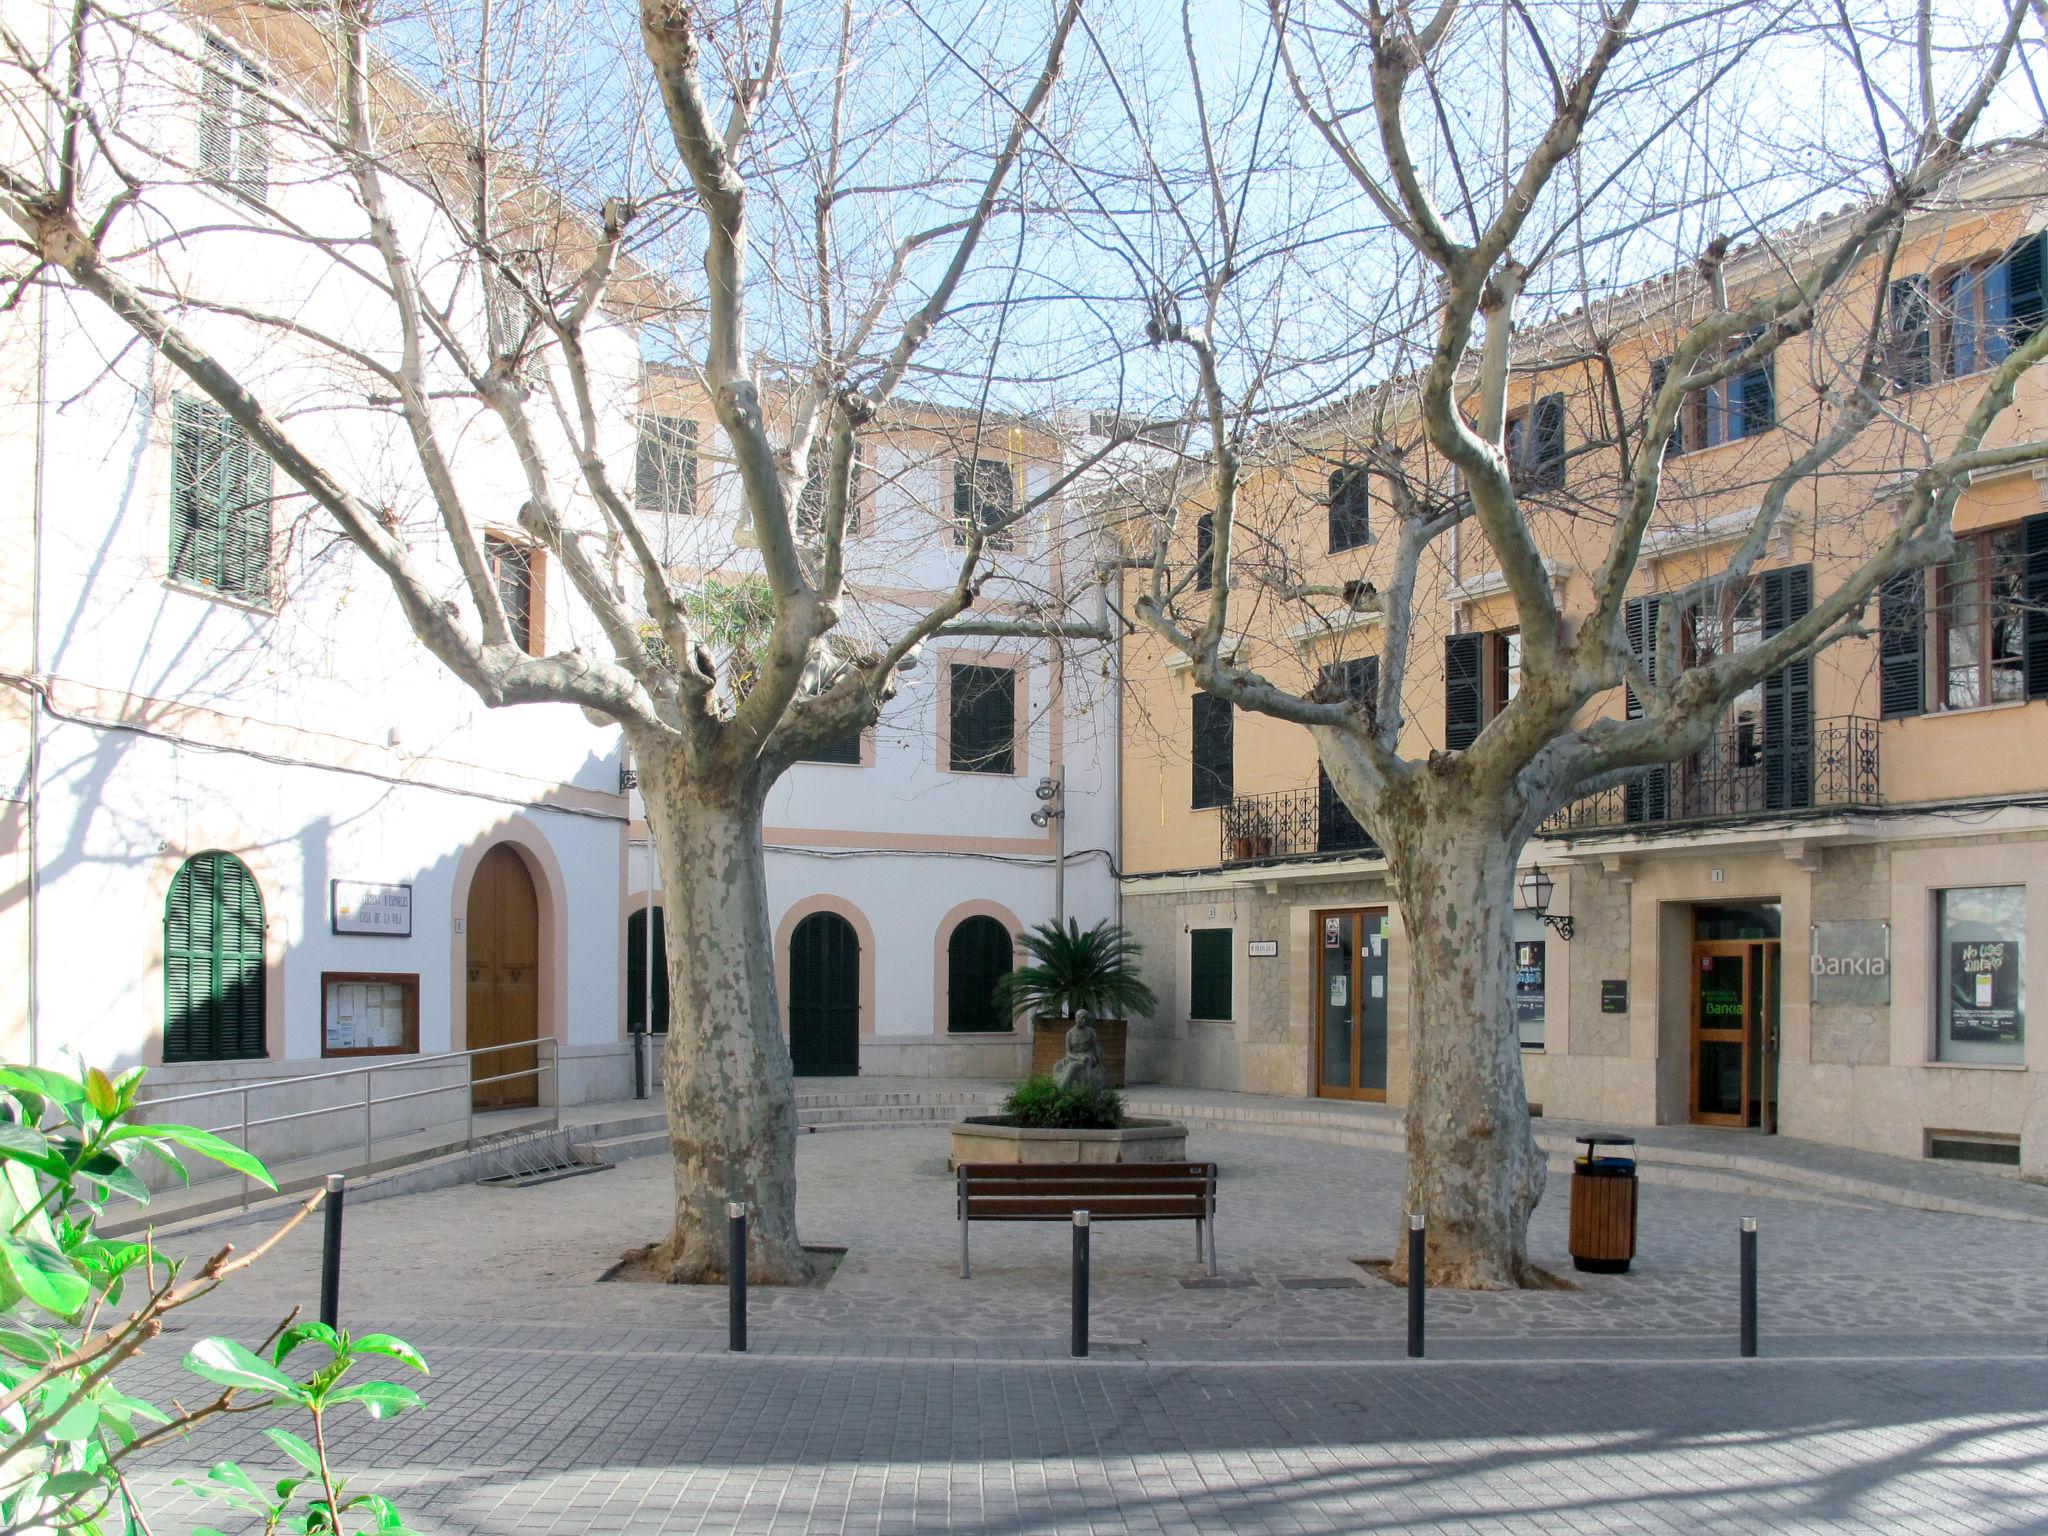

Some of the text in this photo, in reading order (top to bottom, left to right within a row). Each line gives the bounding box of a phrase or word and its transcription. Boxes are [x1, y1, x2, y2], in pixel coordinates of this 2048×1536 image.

[1963, 945, 1978, 960] NO
[1810, 954, 1886, 976] Bankia
[1964, 957, 2003, 972] DINERO
[1706, 1003, 1744, 1015] Bankia
